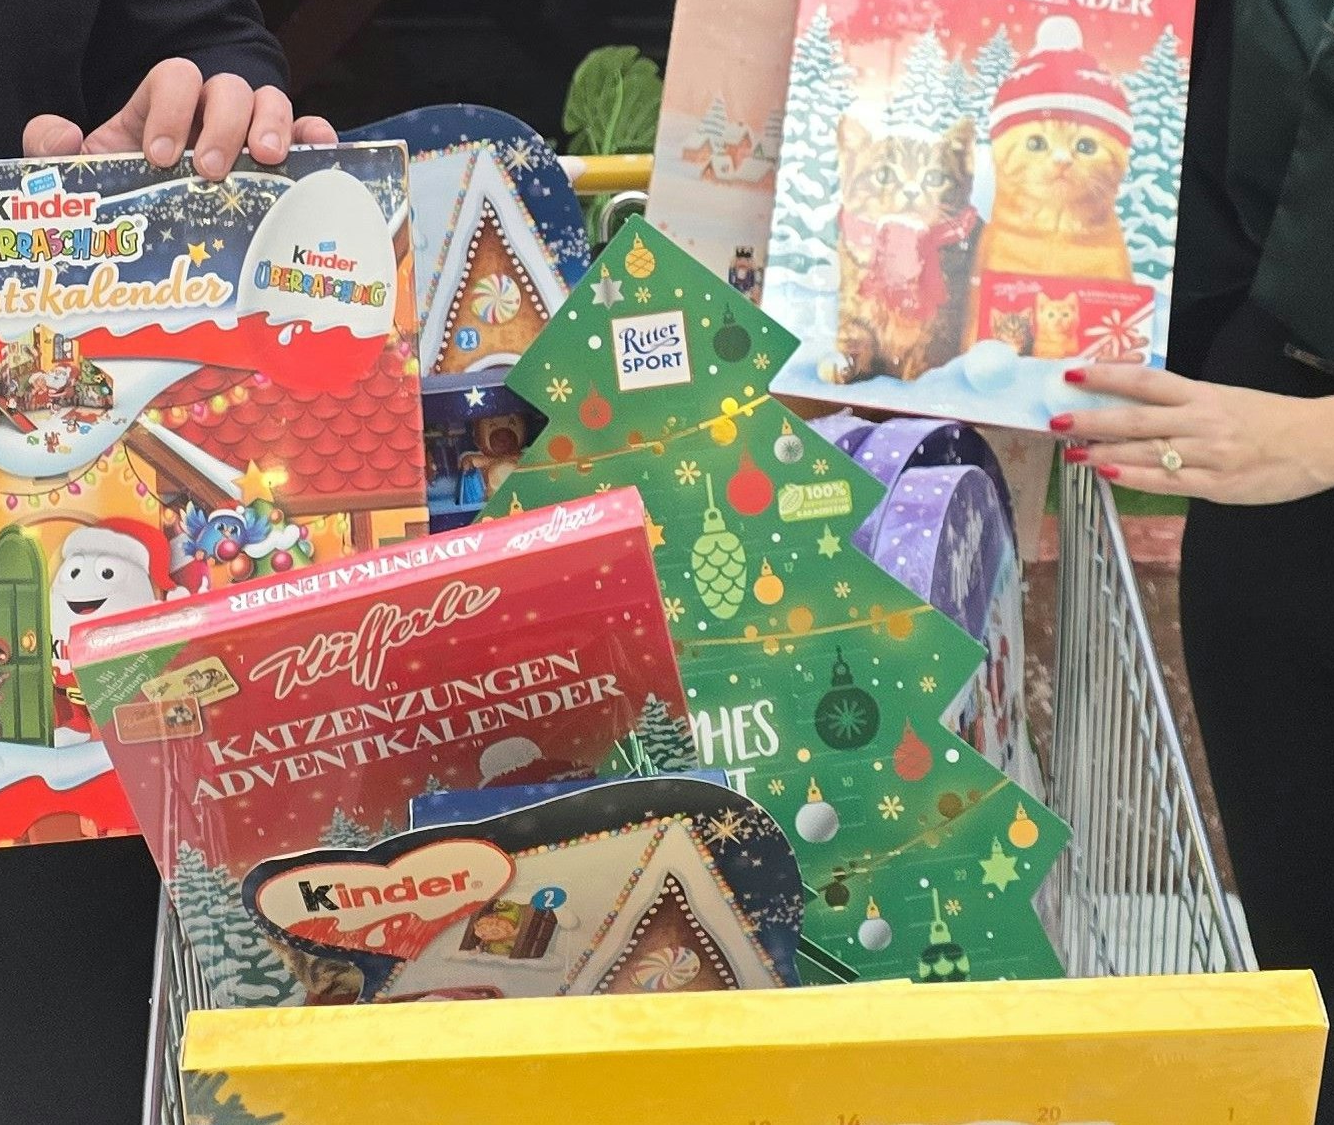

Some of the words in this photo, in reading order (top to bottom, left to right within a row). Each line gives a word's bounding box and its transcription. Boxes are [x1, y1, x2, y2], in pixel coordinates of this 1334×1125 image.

[254, 259, 387, 308] ÜBERRASCHUNG
[459, 330, 478, 350] 23
[618, 323, 680, 355] Ritter
[622, 351, 682, 374] SPORT
[805, 482, 847, 499] 100%
[229, 533, 483, 612] ADVENTKALENDER
[249, 580, 502, 700] Küfferle
[207, 648, 581, 767] KATZENZUNGEN
[192, 673, 625, 806] ADVENTKALENDER
[298, 870, 470, 913] kinder
[544, 890, 555, 908] 2
[1037, 1106, 1062, 1123] 20
[1228, 1107, 1234, 1122] 1
